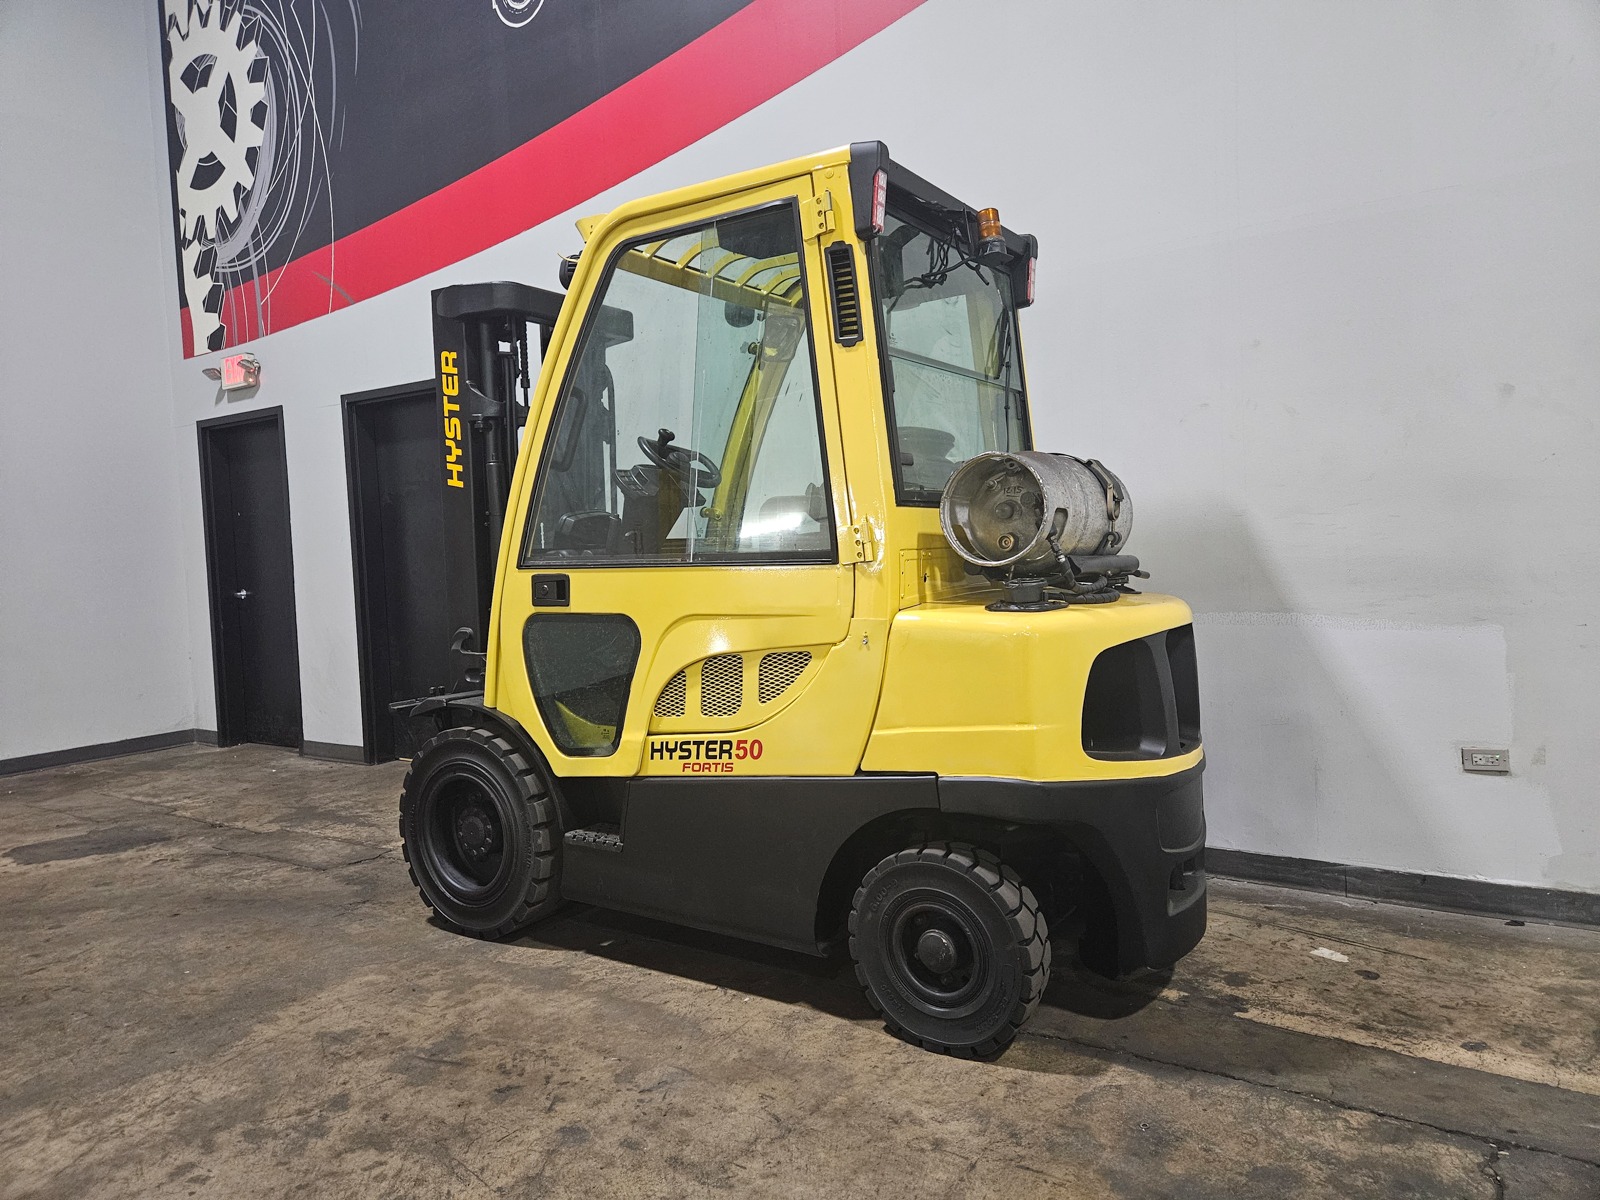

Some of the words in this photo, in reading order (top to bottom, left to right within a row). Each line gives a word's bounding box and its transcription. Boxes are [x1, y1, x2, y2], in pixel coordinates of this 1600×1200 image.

[440, 350, 464, 488] HYSTER
[650, 740, 733, 760] HYSTER
[734, 739, 763, 760] 50
[682, 762, 734, 773] FORTIS
